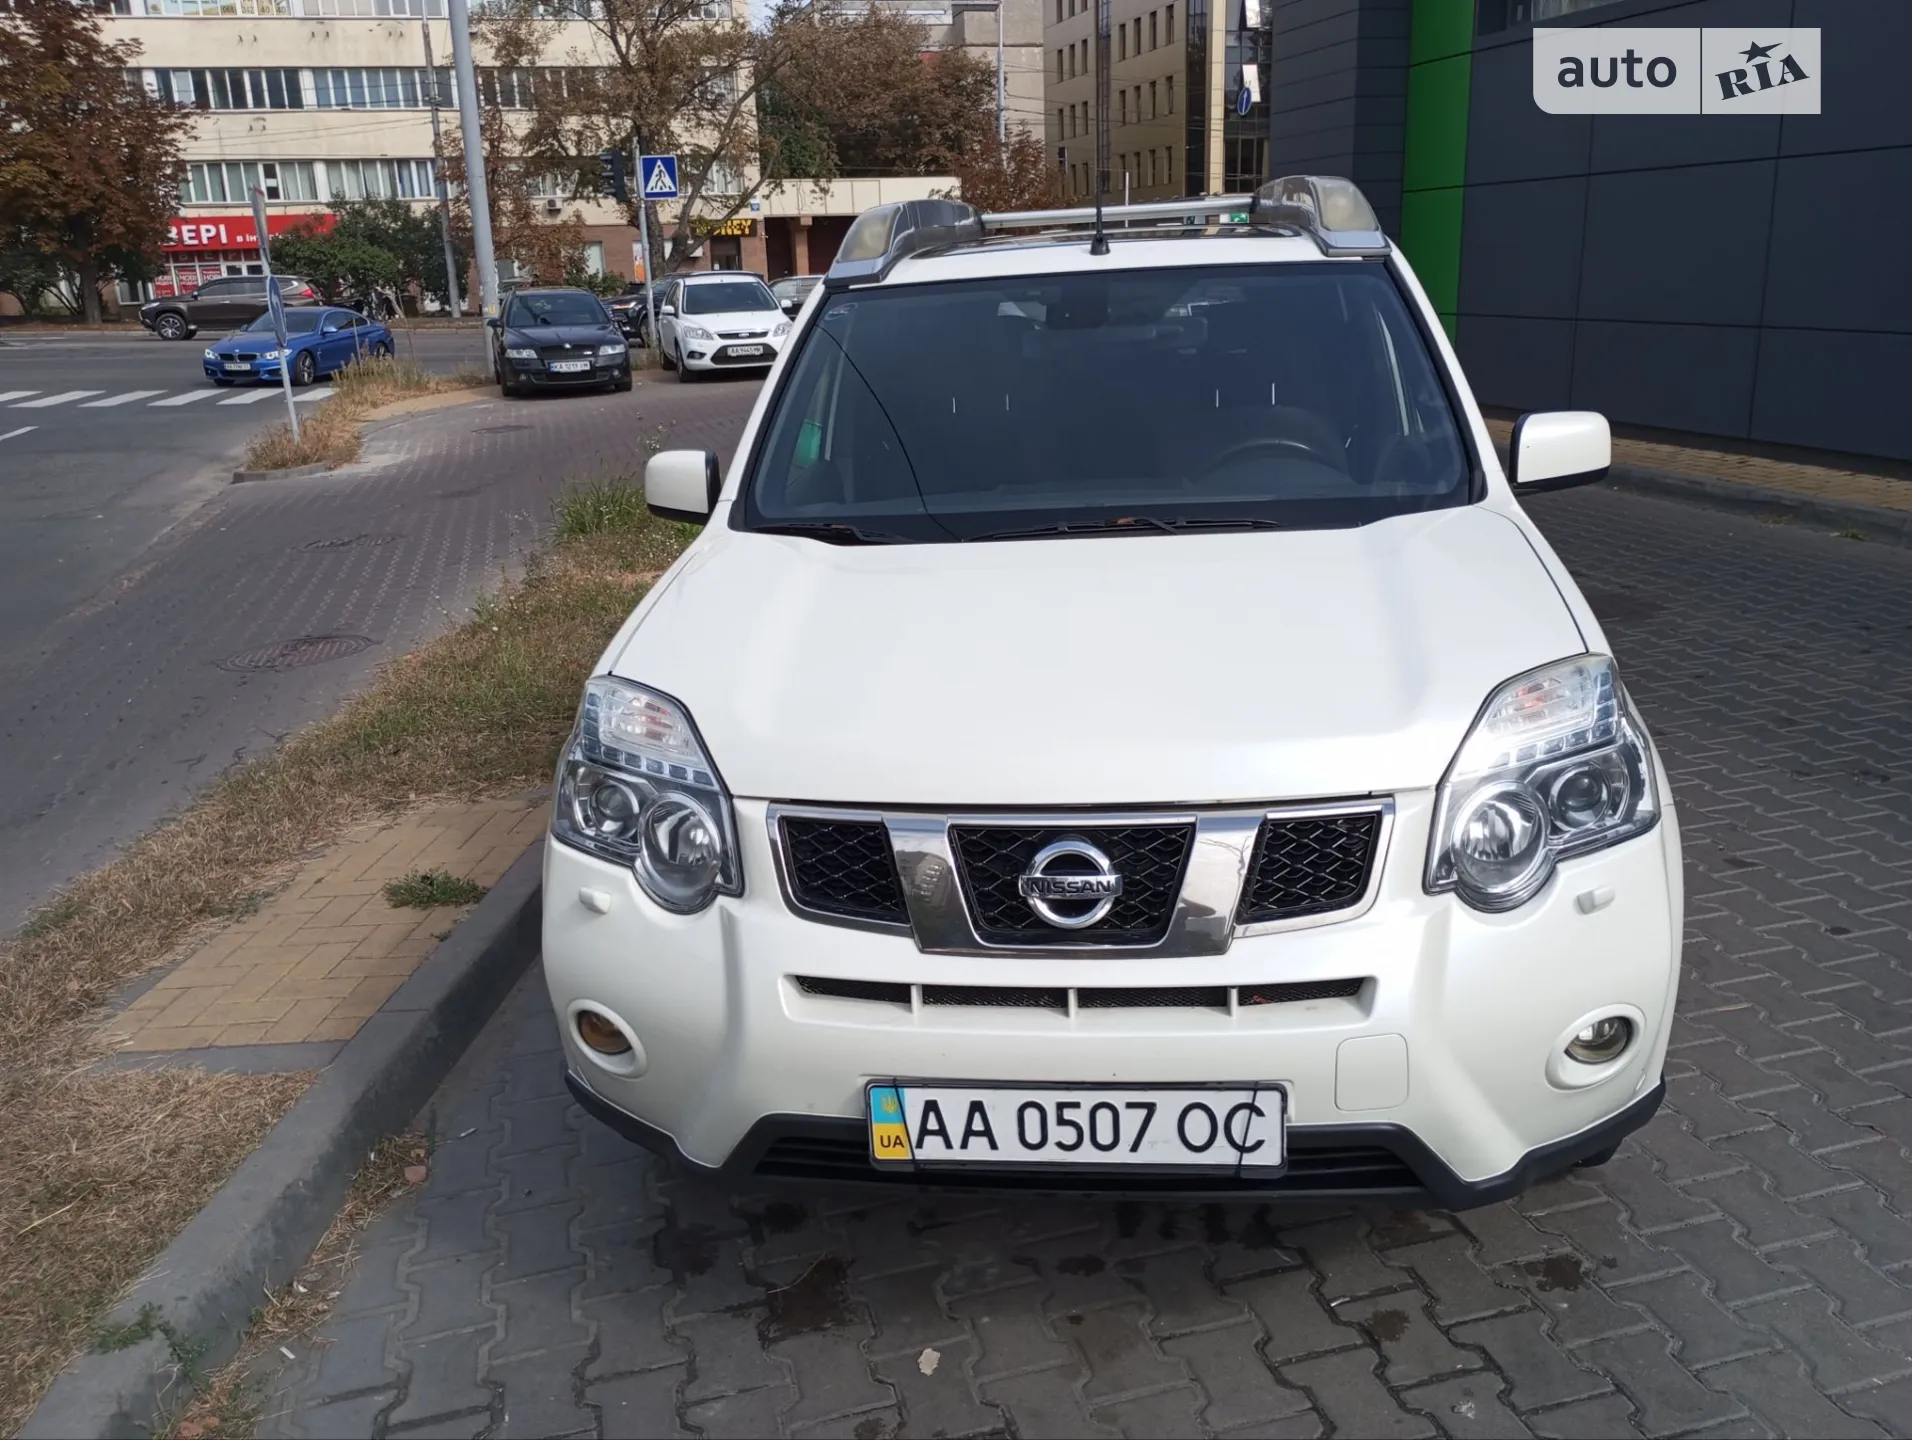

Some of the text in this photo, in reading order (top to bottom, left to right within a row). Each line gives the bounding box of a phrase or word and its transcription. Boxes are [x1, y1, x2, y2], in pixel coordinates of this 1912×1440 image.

[158, 223, 228, 247] ВЕРІ
[1029, 880, 1111, 894] NISSAN
[915, 1100, 1266, 1154] AA 0507 OC
[880, 1134, 904, 1149] UA
